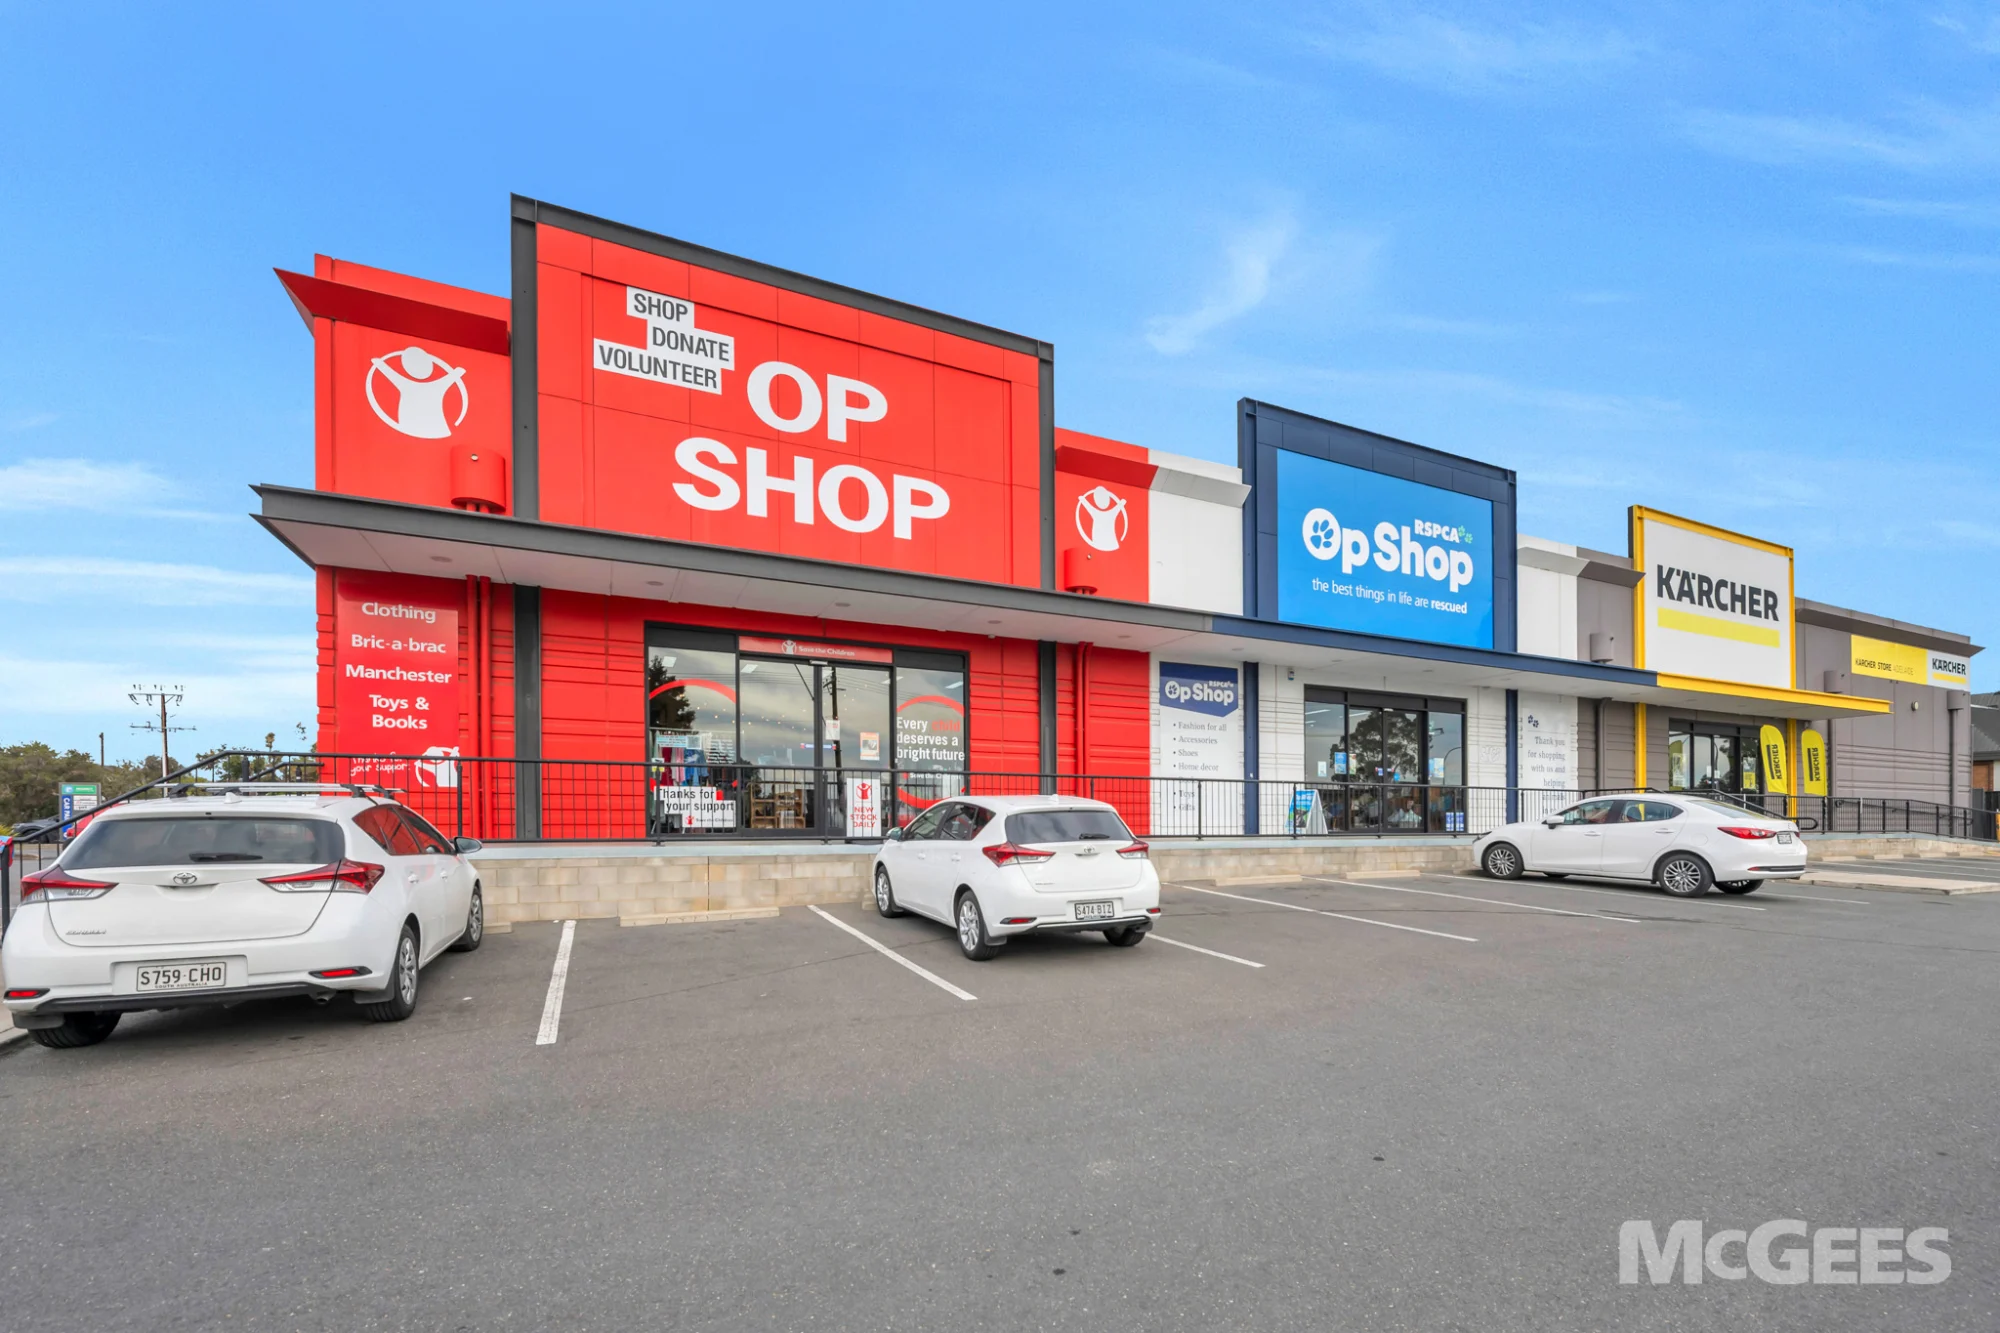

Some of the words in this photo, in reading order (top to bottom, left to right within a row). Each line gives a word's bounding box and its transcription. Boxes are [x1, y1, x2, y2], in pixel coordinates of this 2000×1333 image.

[633, 292, 689, 323] SHOP
[652, 325, 730, 363] DONATE
[599, 345, 718, 390] VOLUNTEER
[746, 360, 888, 443] OP
[671, 436, 951, 541] SHOP
[1414, 518, 1460, 543] RSPCA
[1302, 507, 1370, 575] Op
[1373, 521, 1474, 593] Shop
[1312, 577, 1329, 593] the
[1332, 580, 1353, 597] best
[1355, 584, 1385, 604] things
[1387, 589, 1396, 604] in
[1399, 591, 1412, 606] life
[1415, 597, 1428, 609] are
[1431, 599, 1468, 614] rescued
[1657, 564, 1779, 621] KÄRCHER
[361, 602, 436, 624] Clothing
[352, 633, 446, 653] Bric-a-brac
[345, 663, 452, 684] Manchester
[1877, 661, 1892, 672] STORE
[1165, 680, 1191, 703] Op
[1192, 683, 1234, 706] Shop
[369, 694, 409, 712] Toys
[415, 697, 430, 711] &
[372, 714, 428, 730] Books
[896, 716, 928, 733] Every
[931, 719, 961, 732] child
[1178, 721, 1206, 731] Fashion
[1207, 722, 1217, 731] for
[1218, 724, 1227, 732] all
[896, 732, 948, 746] deserves
[951, 736, 959, 746] a
[1178, 735, 1218, 745] Accessories
[1534, 736, 1554, 745] Thank
[1554, 739, 1566, 747] you
[896, 746, 930, 762] bright
[931, 748, 965, 761] future
[1527, 749, 1537, 758] for
[1538, 750, 1566, 761] shopping
[350, 765, 372, 777] your
[1178, 762, 1199, 771] Home
[1531, 764, 1545, 773] with
[659, 788, 696, 799] hanks
[699, 788, 715, 799] for
[63, 797, 71, 810] CAR
[666, 802, 690, 812] your
[694, 801, 734, 813] support
[140, 969, 181, 986] S759
